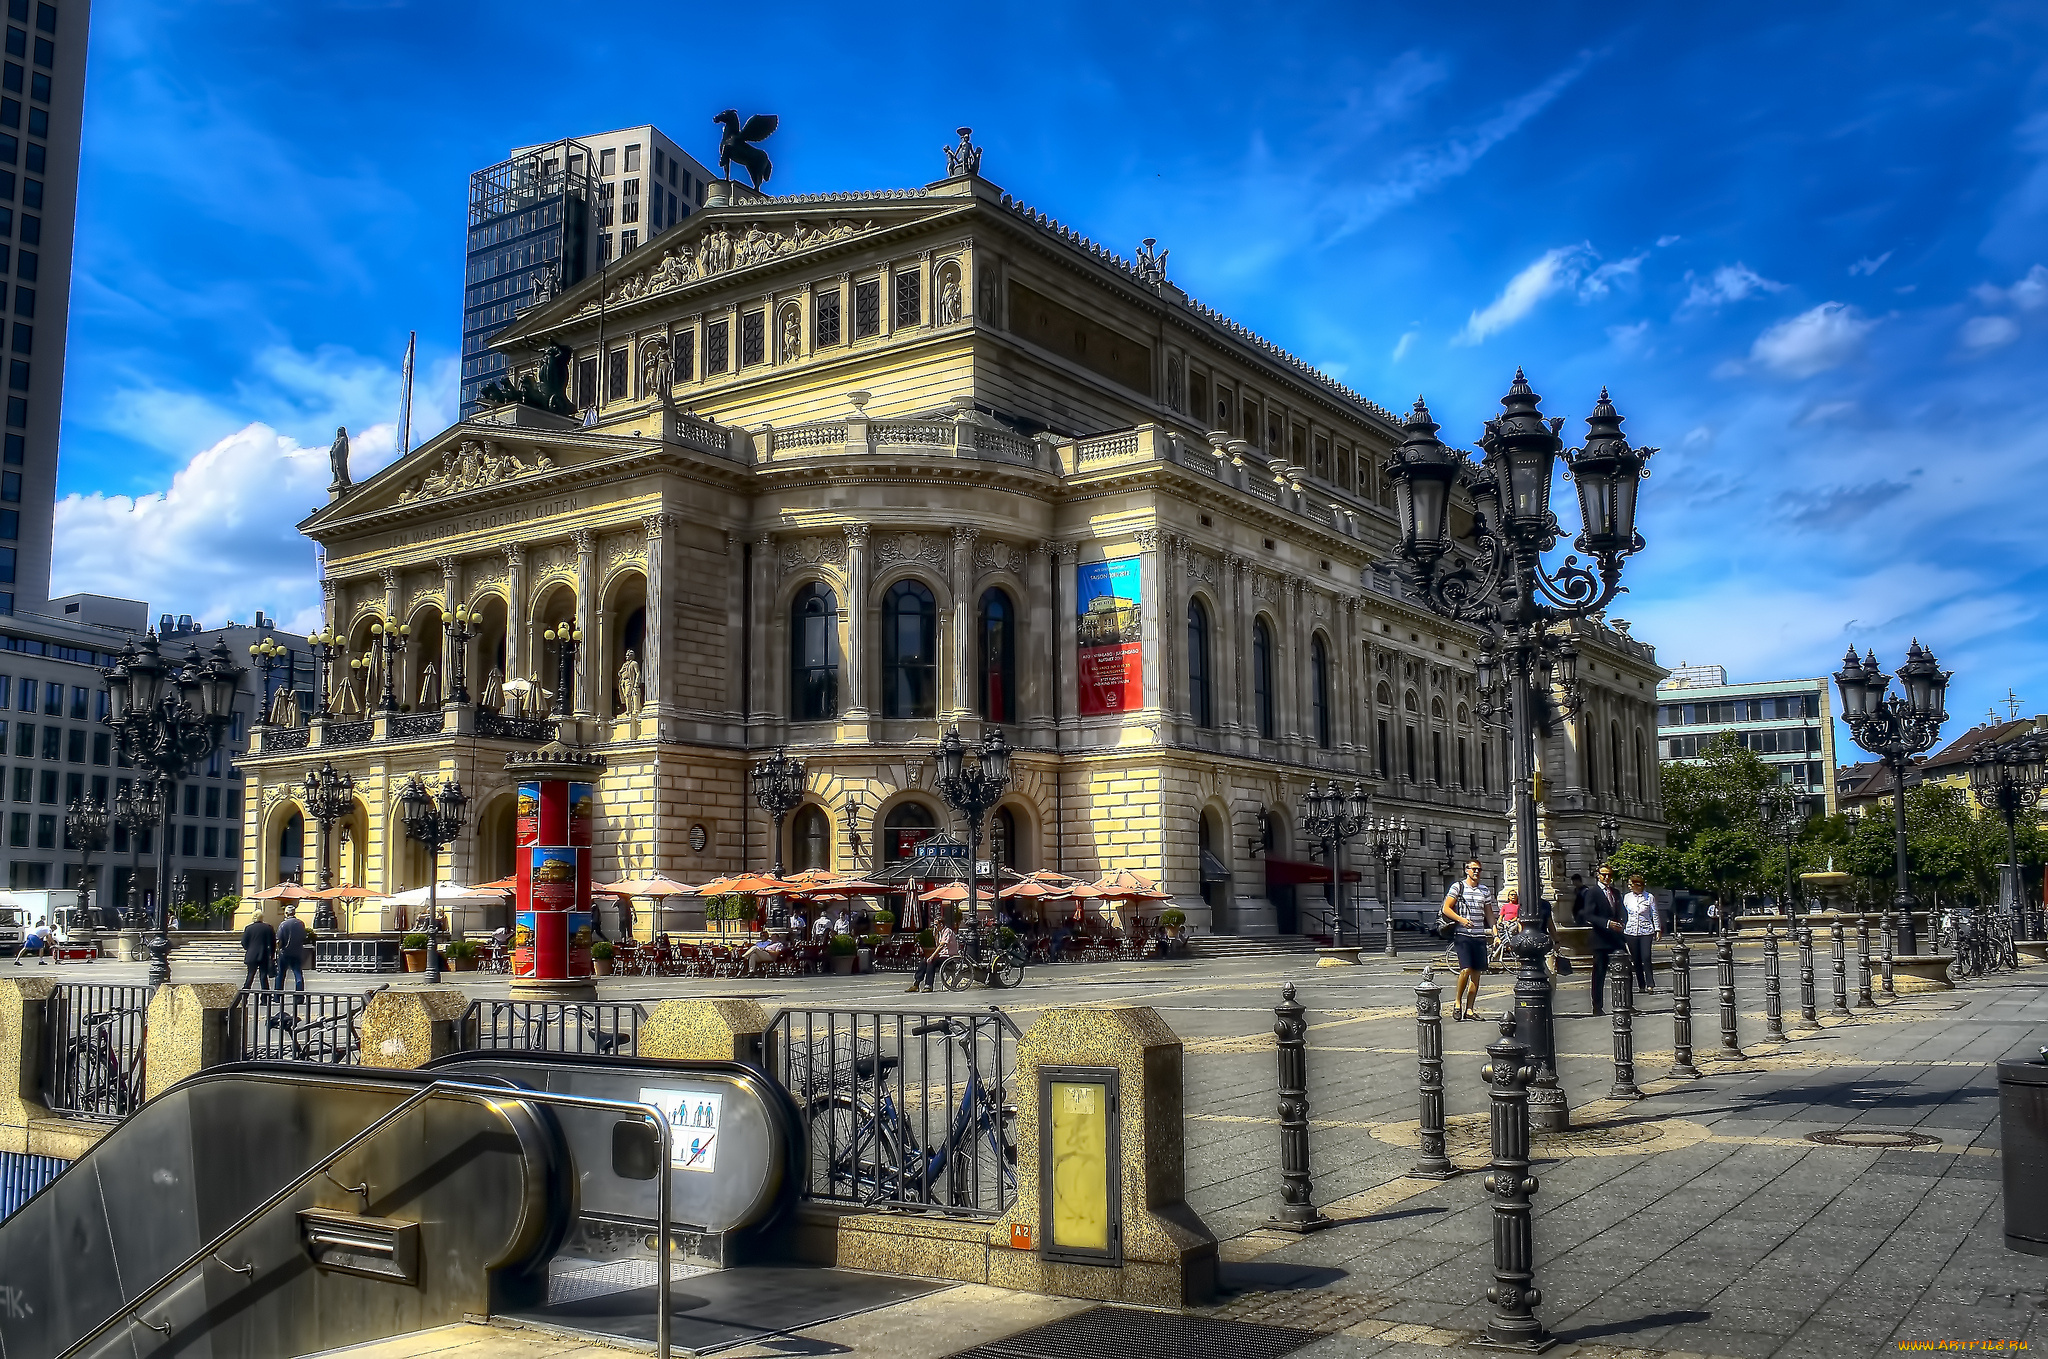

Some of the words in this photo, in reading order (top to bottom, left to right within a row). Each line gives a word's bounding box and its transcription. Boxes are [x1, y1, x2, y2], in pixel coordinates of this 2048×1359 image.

[413, 522, 460, 545] WAHREN
[466, 508, 529, 531] SCHOENEN
[535, 498, 578, 518] GUTEN
[940, 848, 946, 856] P
